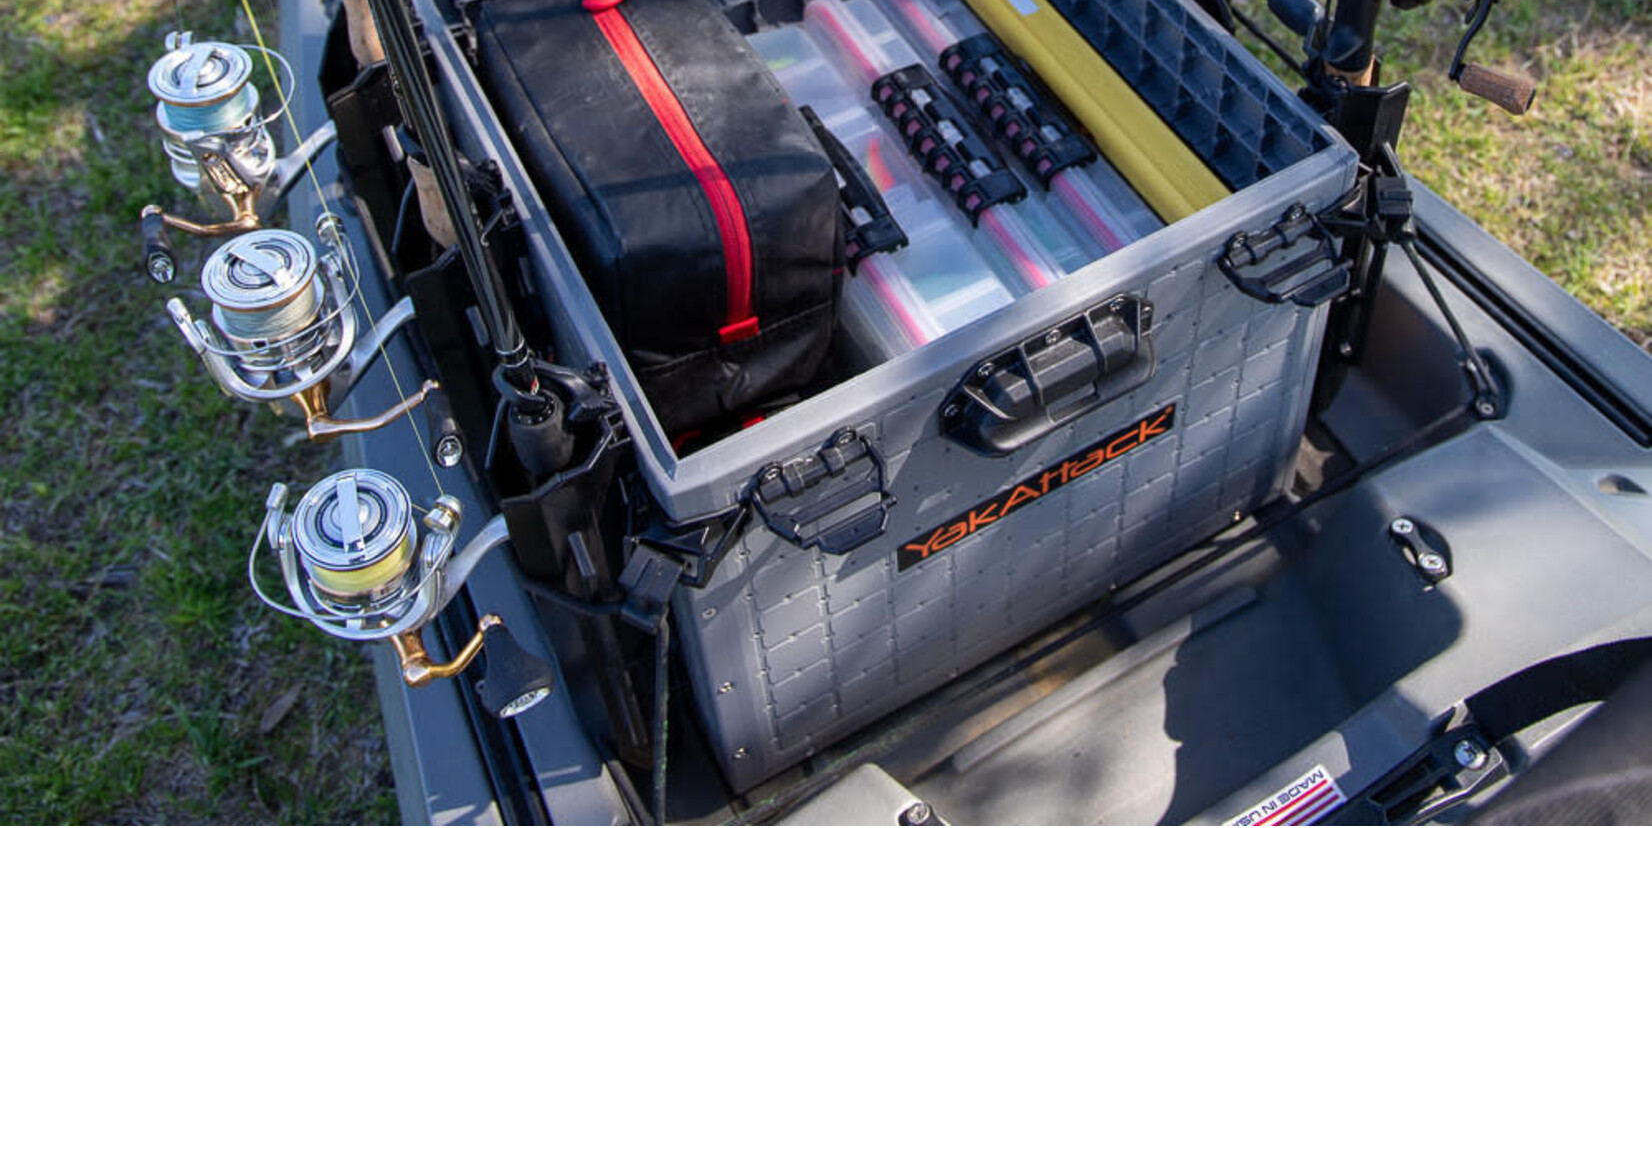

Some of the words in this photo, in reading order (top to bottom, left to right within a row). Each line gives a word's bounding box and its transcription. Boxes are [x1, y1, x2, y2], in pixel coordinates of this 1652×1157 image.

[905, 405, 1174, 558] YakAttack
[1277, 770, 1324, 805] MADE
[1261, 800, 1278, 814] IN
